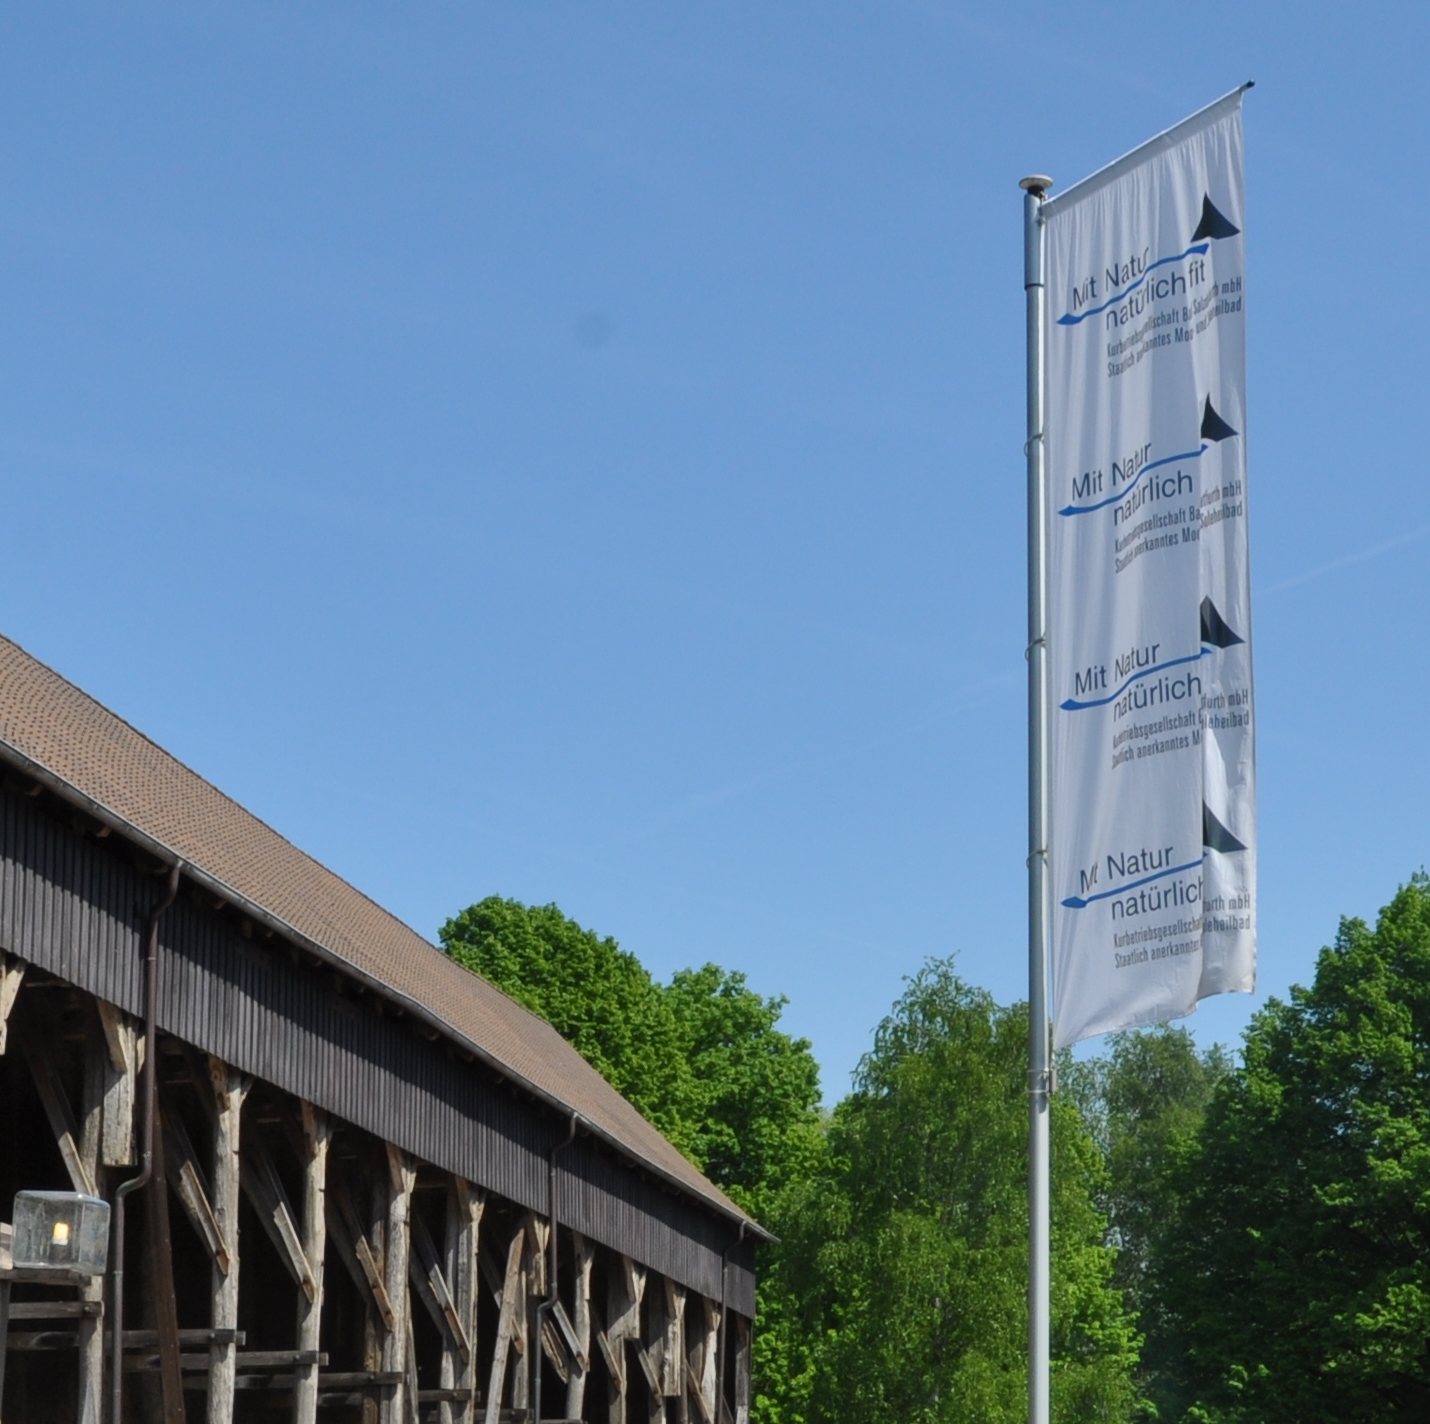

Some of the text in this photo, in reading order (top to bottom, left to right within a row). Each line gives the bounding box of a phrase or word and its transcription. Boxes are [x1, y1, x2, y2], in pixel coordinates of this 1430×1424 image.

[1188, 259, 1206, 288] fit
[1221, 276, 1242, 294] mbH
[1072, 442, 1151, 502] Mit Natur
[1221, 480, 1242, 497] mbH
[1113, 470, 1193, 527] natürlich
[1075, 643, 1160, 696] Mit Natur
[1113, 672, 1202, 722] natürlich
[1106, 846, 1174, 880] Natur
